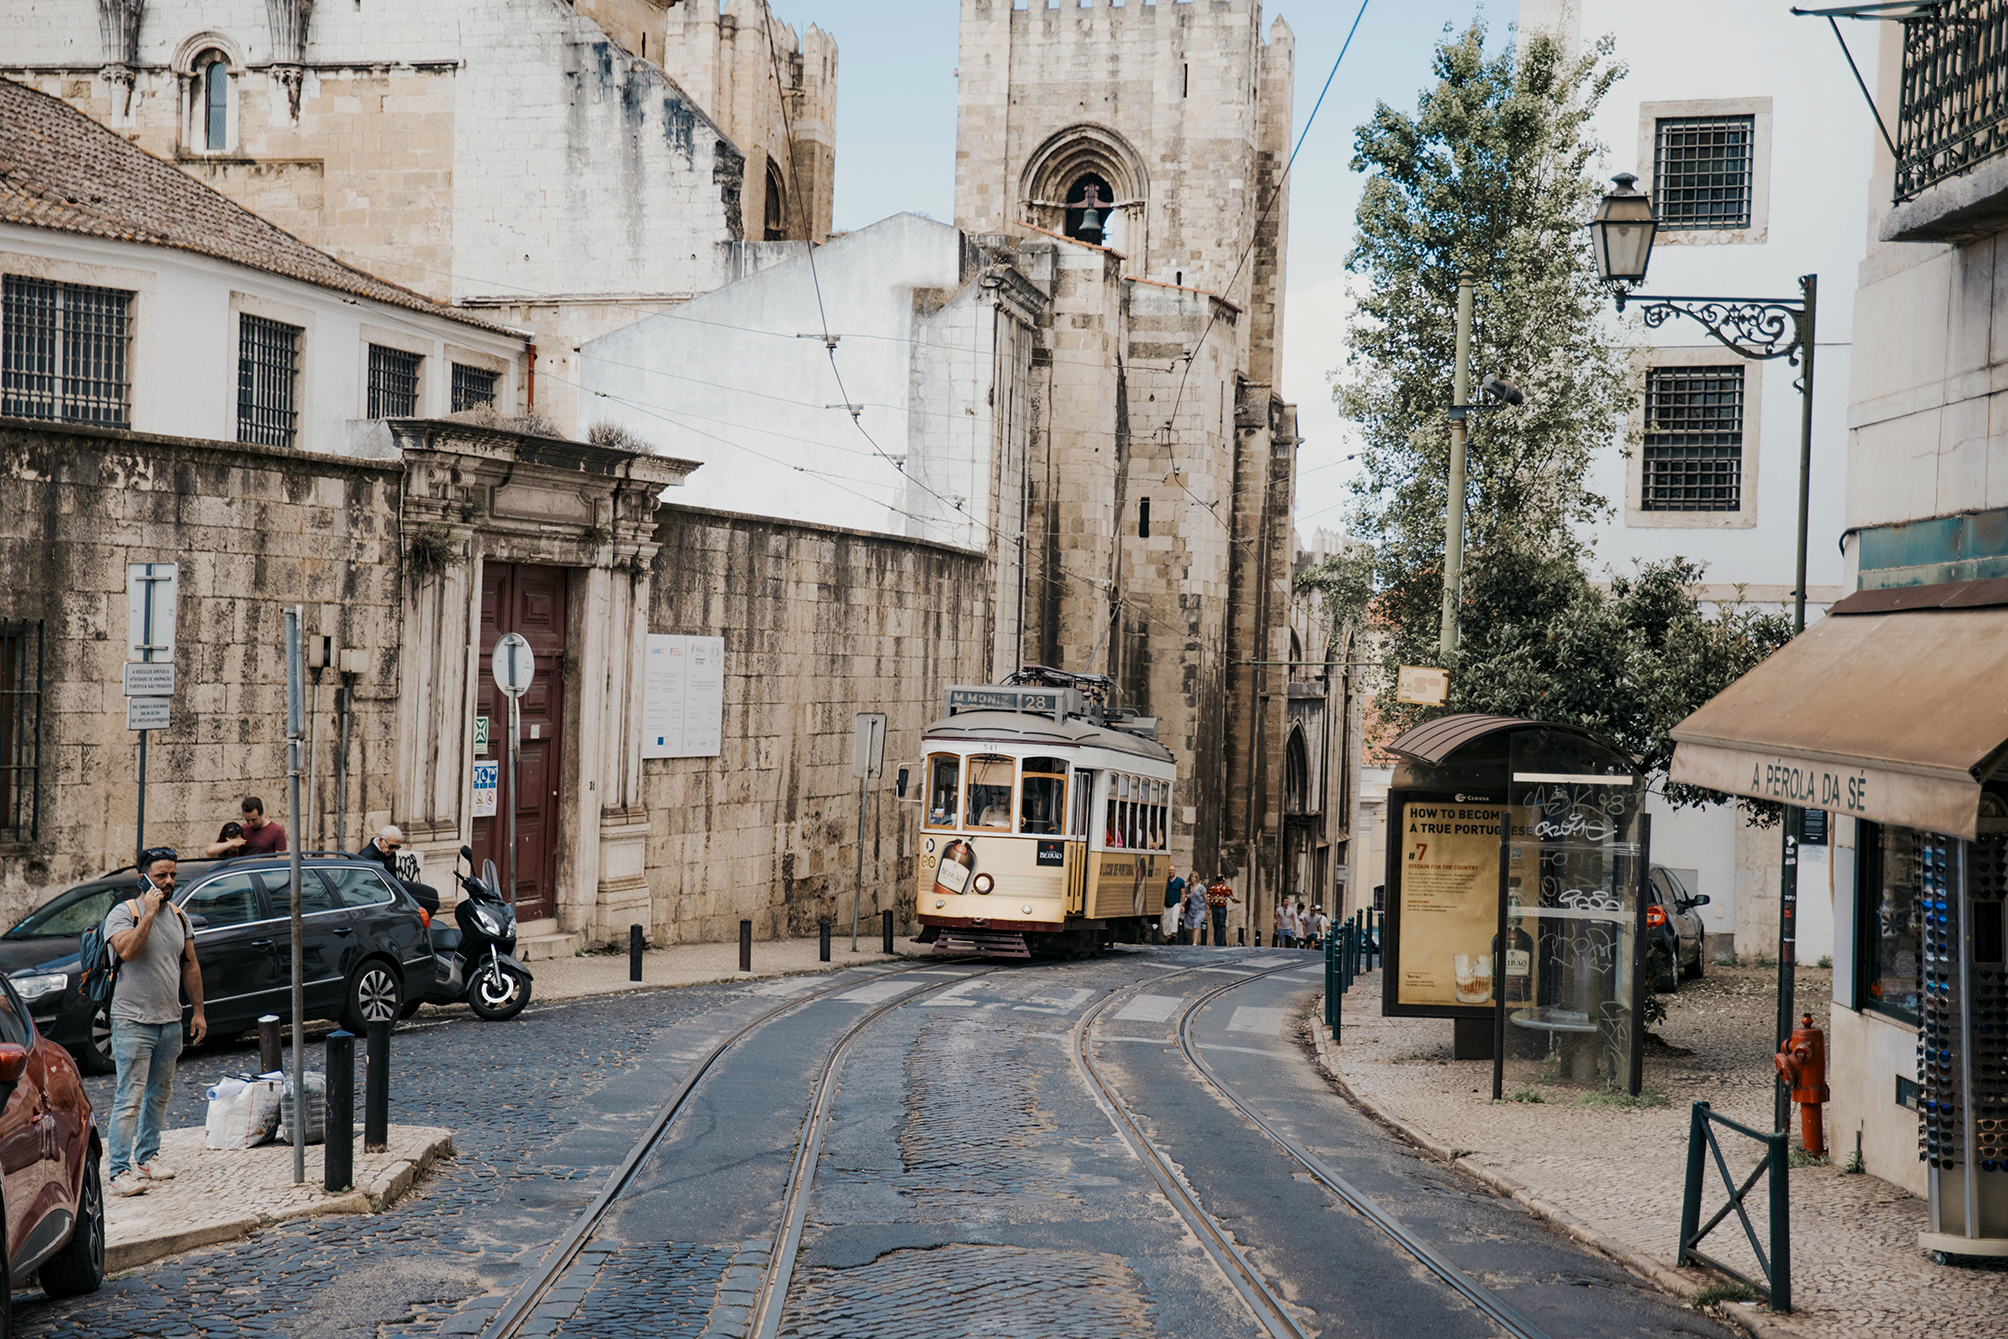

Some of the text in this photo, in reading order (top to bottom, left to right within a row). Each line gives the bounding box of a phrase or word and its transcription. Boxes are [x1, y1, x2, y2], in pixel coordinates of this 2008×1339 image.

[967, 693, 1010, 704] MONIZ
[1026, 696, 1046, 709] 28
[1751, 758, 1866, 811] A PÉROLA DA SÉ
[1410, 808, 1507, 820] HOW TO BECOM
[1409, 824, 1533, 836] A TRUE PORTUGESE
[1408, 843, 1428, 860] #7
